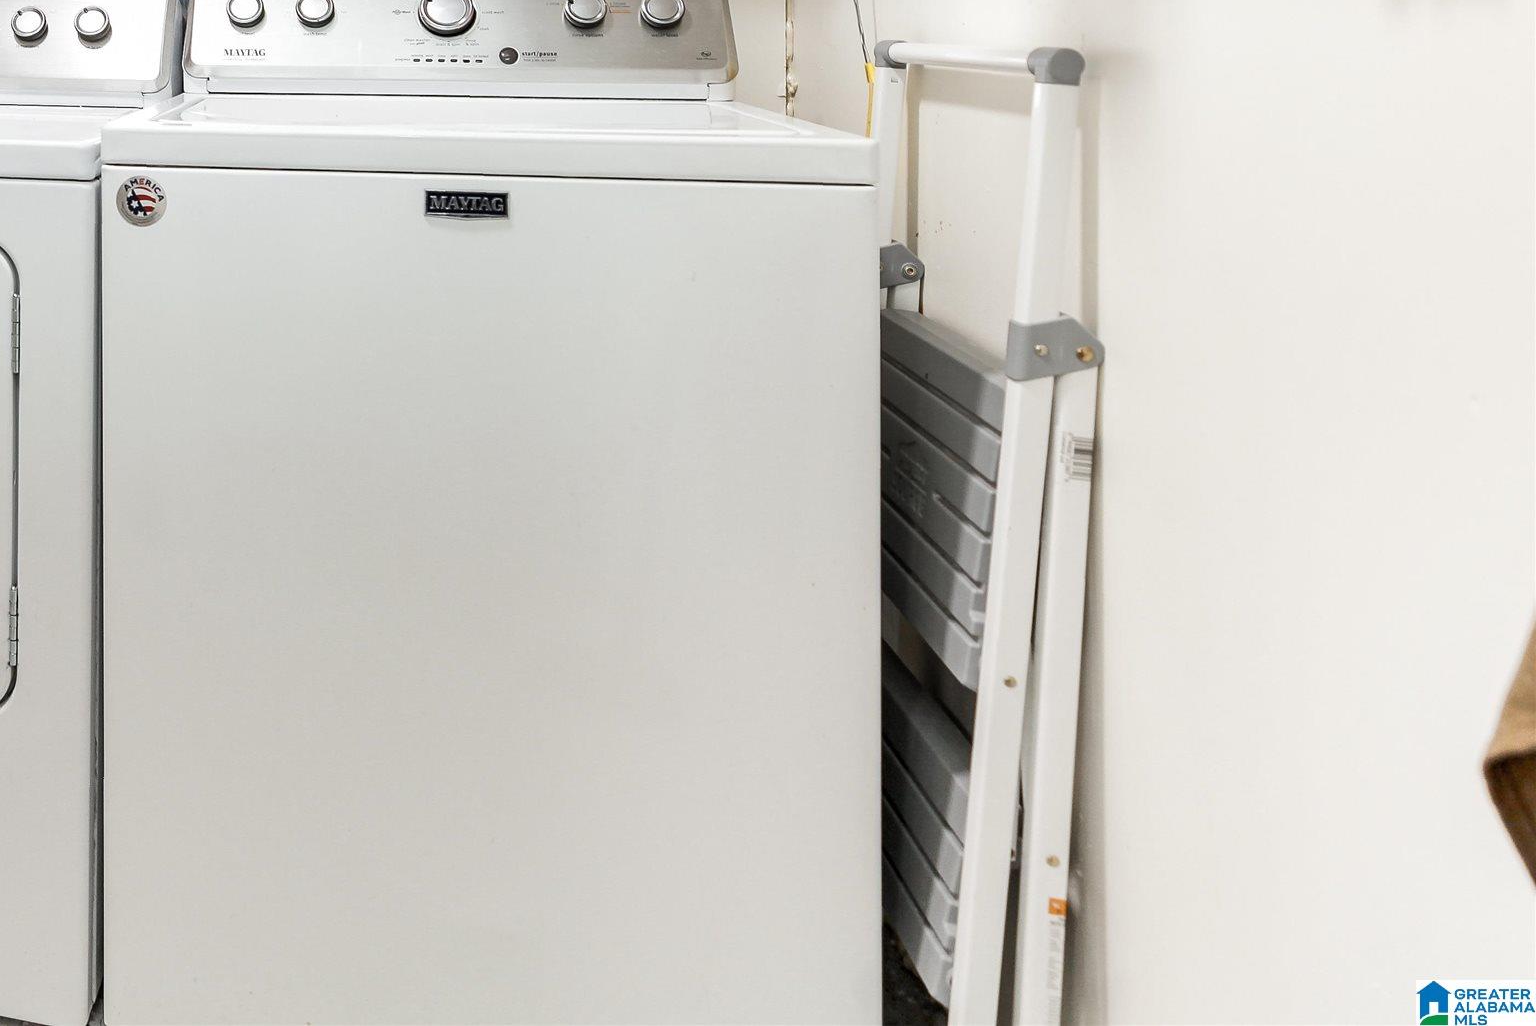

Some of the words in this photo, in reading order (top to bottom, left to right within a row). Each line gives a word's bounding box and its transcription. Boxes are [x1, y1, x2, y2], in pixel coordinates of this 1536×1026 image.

[224, 48, 266, 56] MAYTAG
[521, 50, 559, 58] start/pause
[122, 177, 165, 203] AMERICA
[429, 195, 505, 213] MAYTAG
